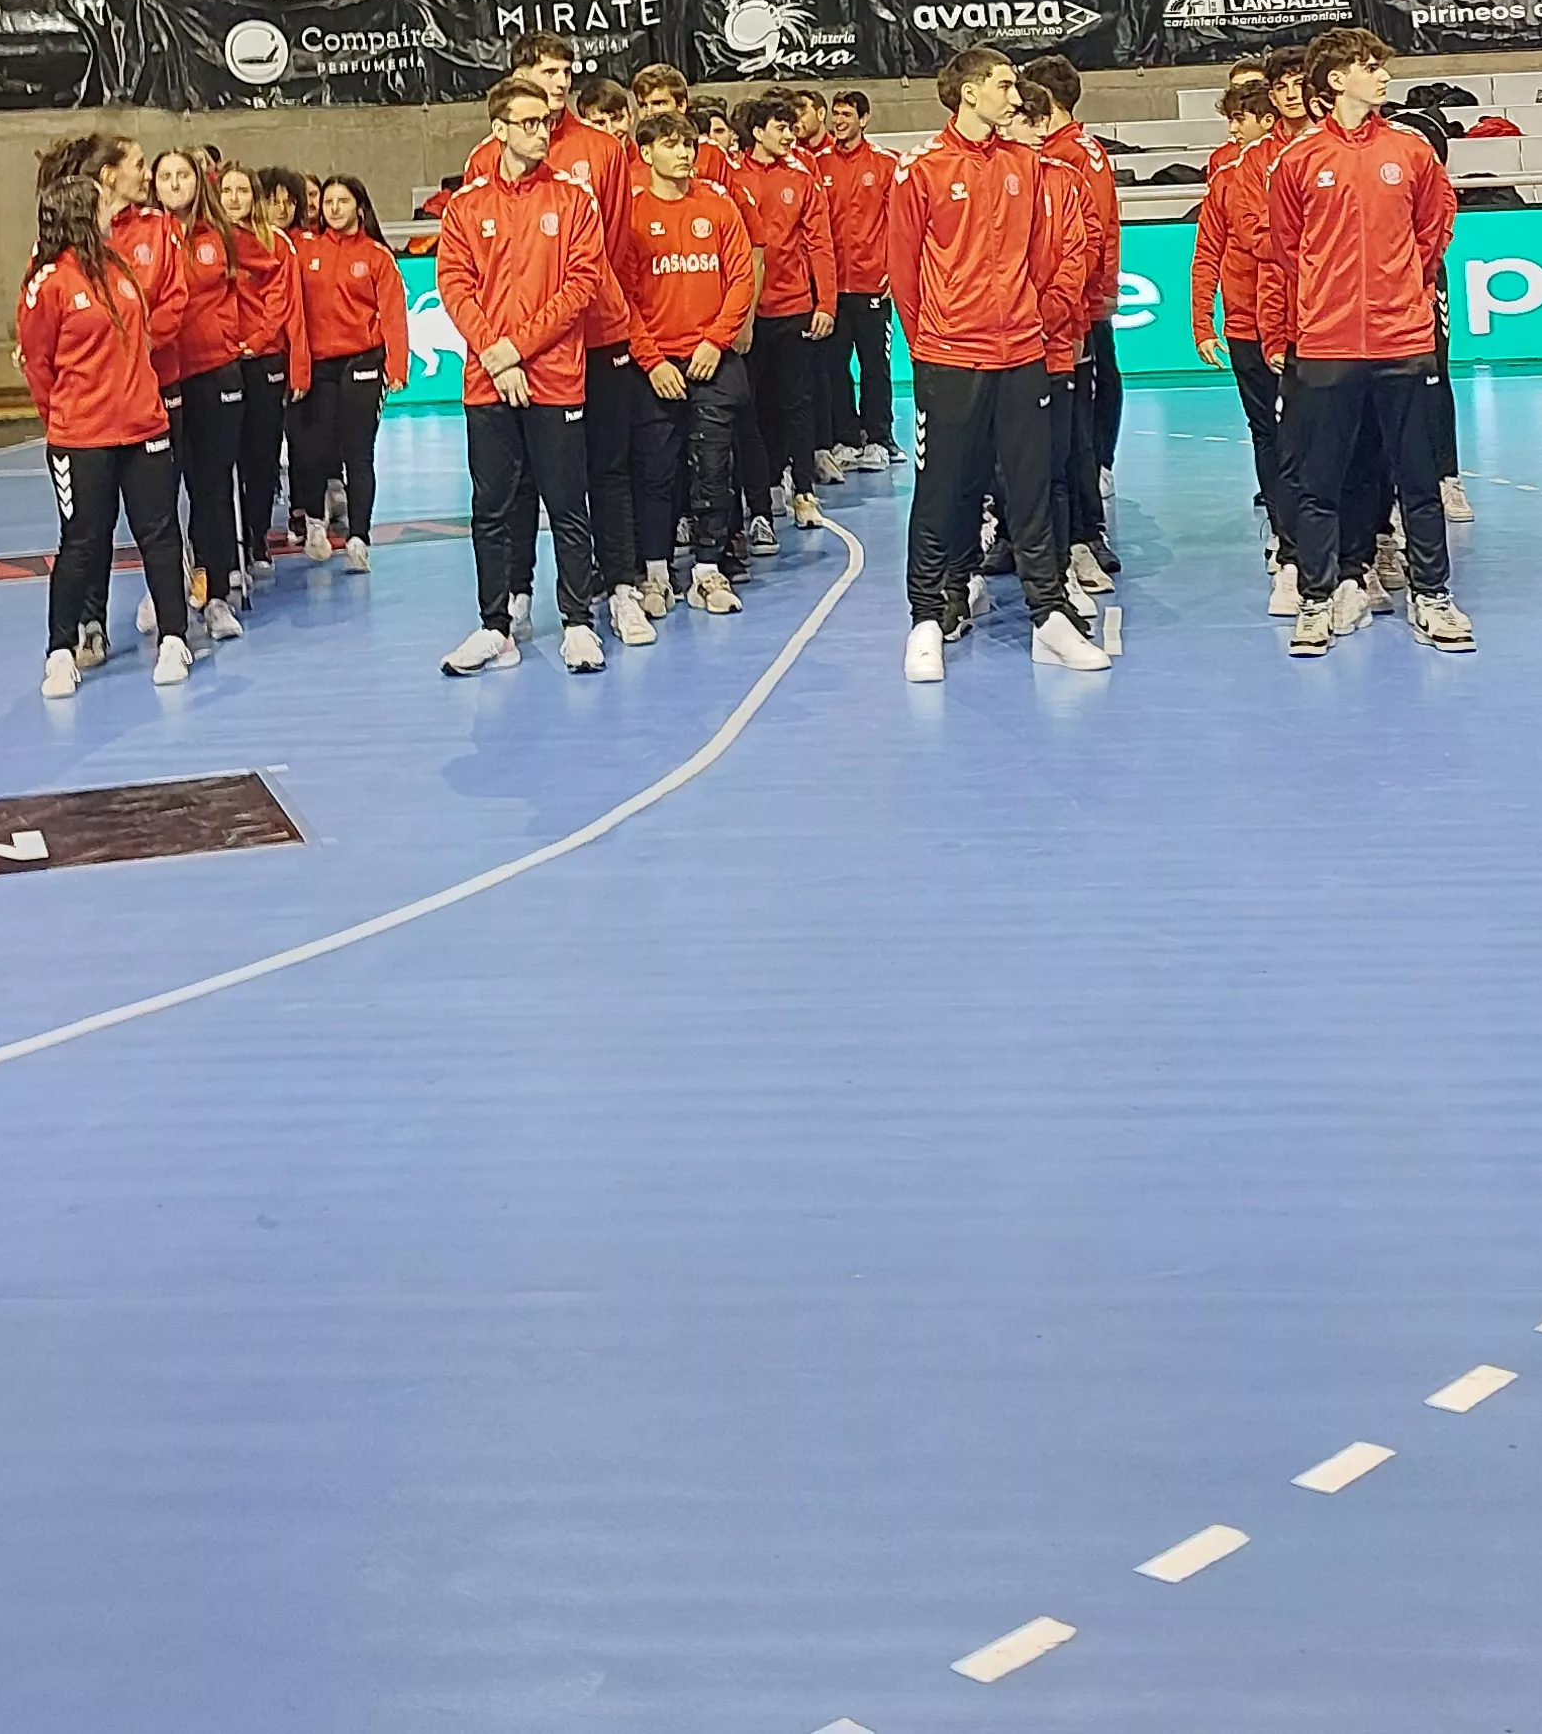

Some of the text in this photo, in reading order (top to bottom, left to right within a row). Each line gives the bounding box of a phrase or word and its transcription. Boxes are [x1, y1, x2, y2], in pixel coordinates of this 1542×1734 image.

[913, 0, 1063, 30] avanza
[1411, 3, 1527, 29] pirineos
[301, 22, 439, 55] Compaire
[652, 254, 720, 275] LASAOSA
